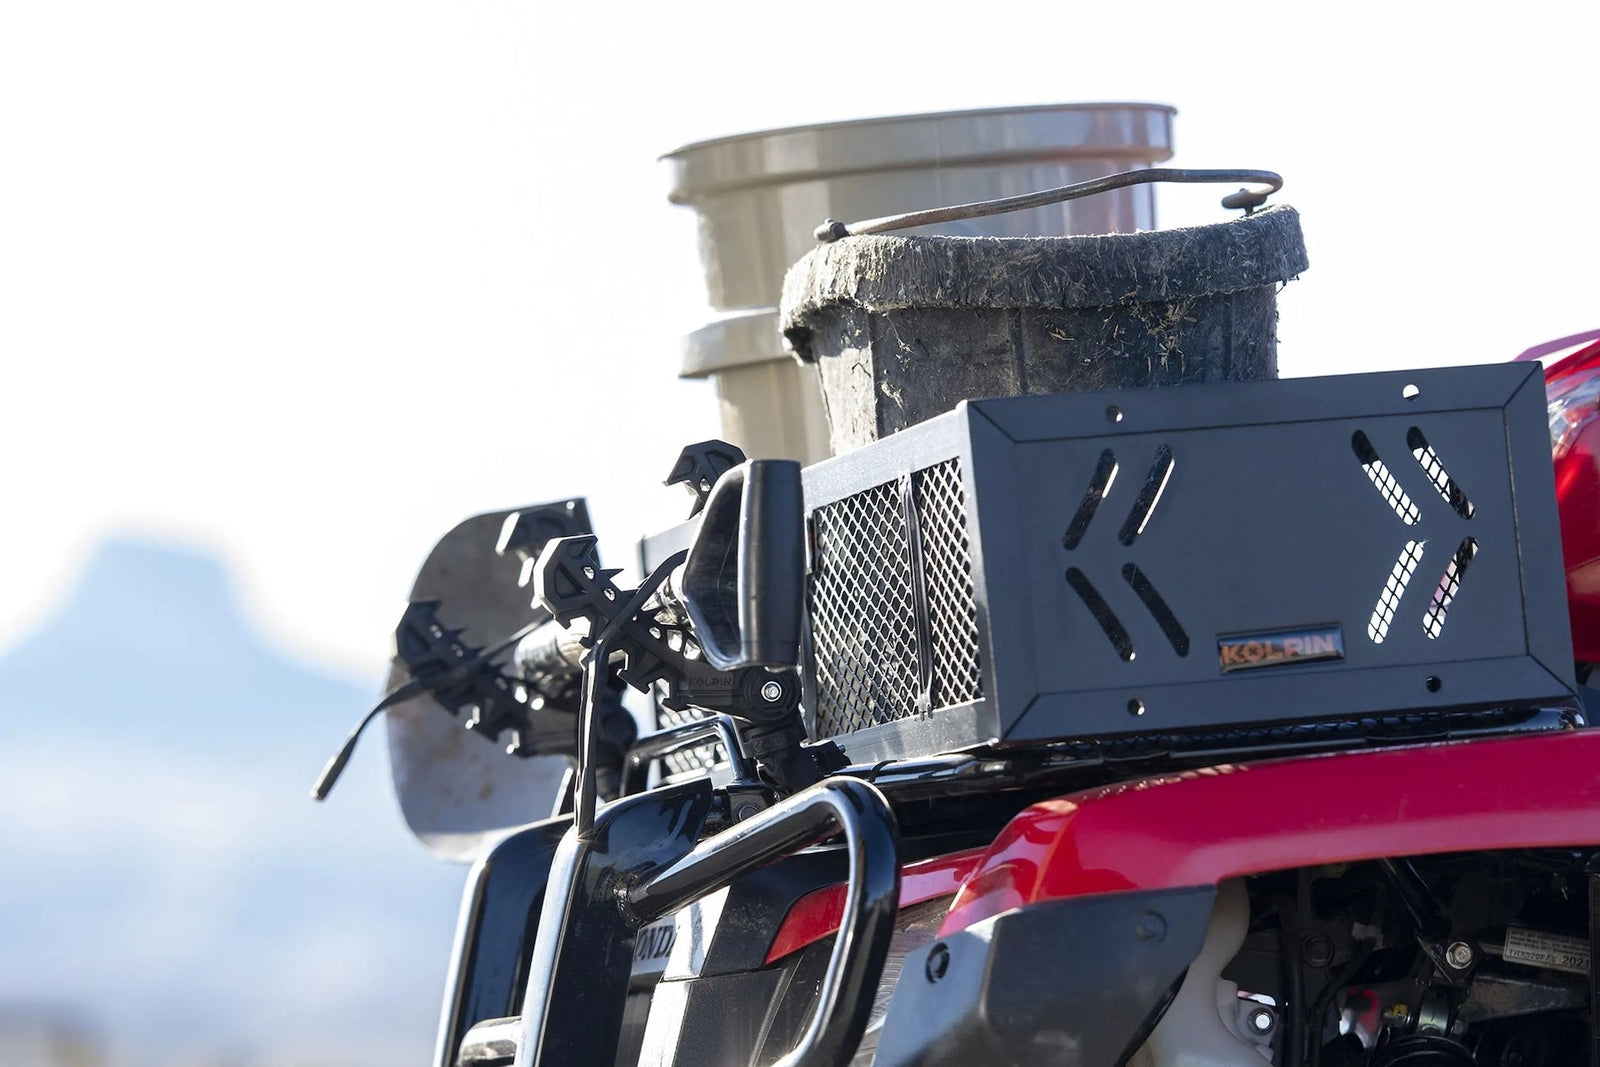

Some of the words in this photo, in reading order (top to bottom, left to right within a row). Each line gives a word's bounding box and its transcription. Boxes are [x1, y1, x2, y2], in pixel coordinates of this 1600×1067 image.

[1221, 633, 1335, 665] KOLPIN
[637, 925, 678, 960] OND
[1561, 955, 1590, 969] 2021
